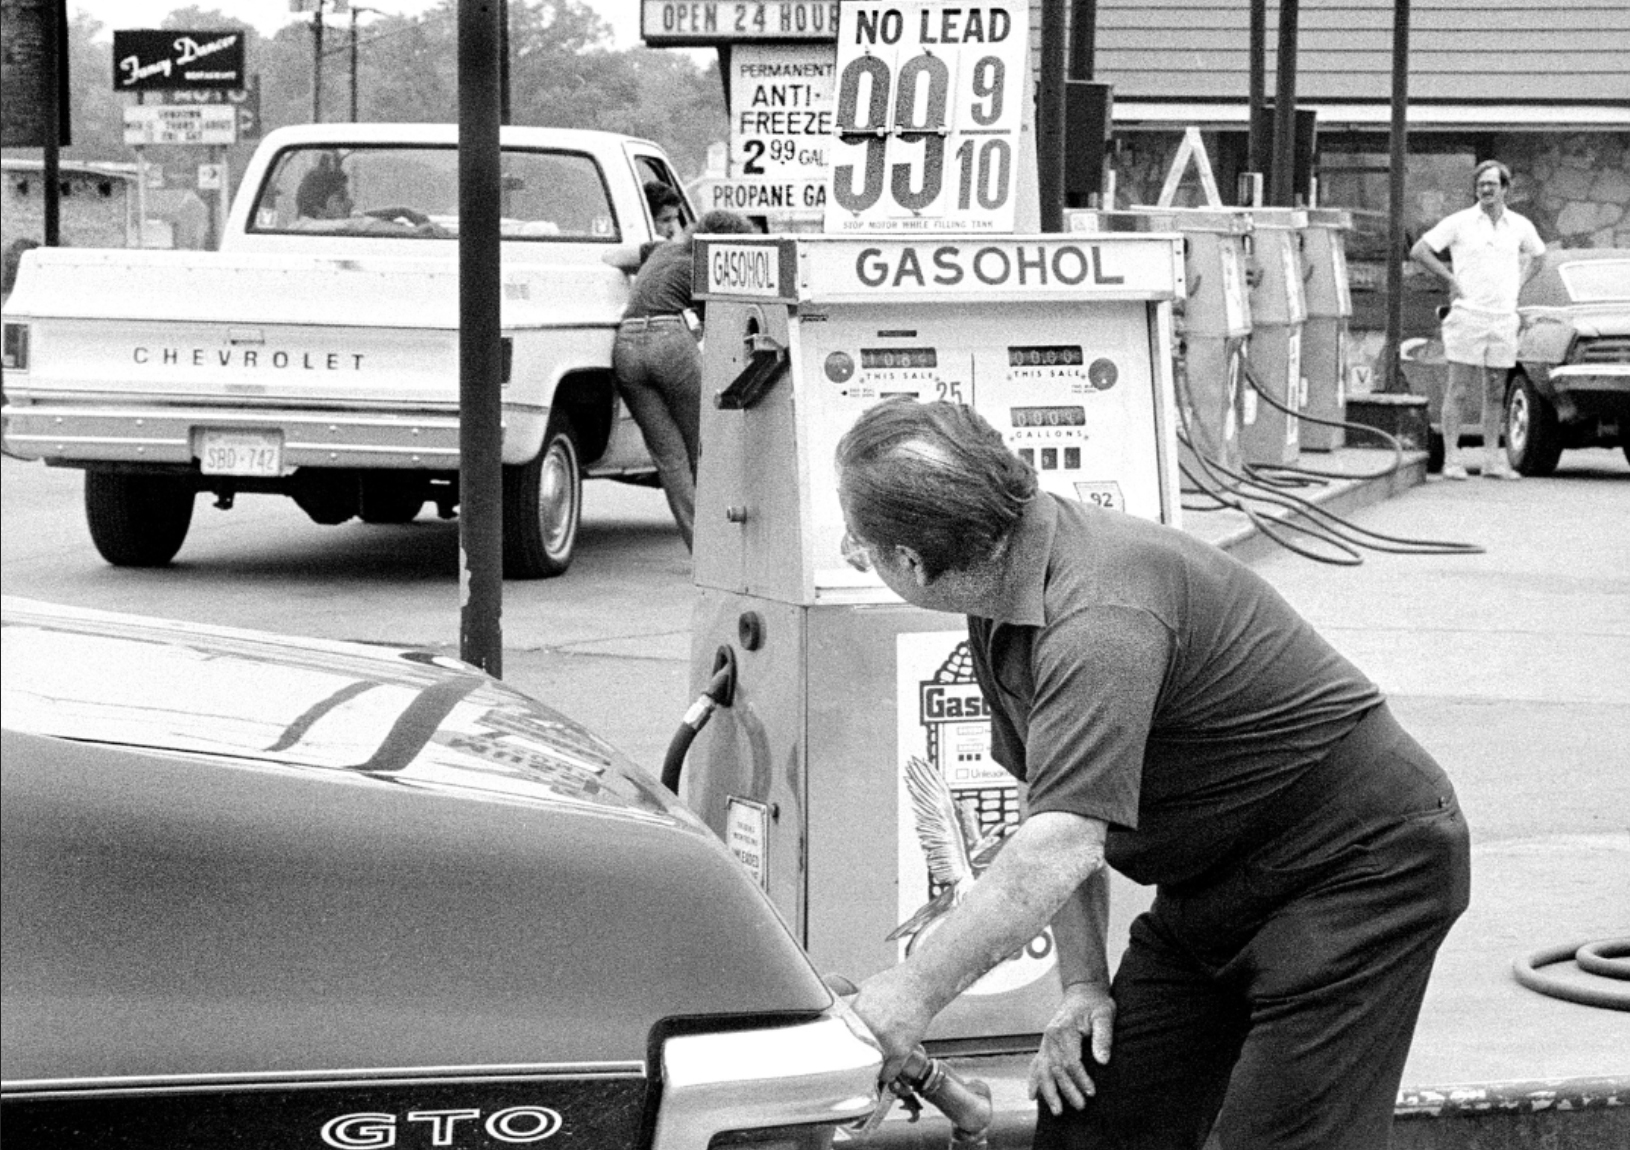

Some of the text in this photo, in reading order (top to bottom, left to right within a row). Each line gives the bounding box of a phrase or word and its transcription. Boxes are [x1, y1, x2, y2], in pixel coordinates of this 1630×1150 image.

[662, 3, 717, 33] OPEN
[734, 3, 766, 33] 24
[855, 8, 1012, 45] NO LEAD
[740, 62, 836, 77] PERMANENT
[740, 110, 833, 135] FREEZE
[832, 54, 949, 212] 99
[712, 184, 796, 208] PROPANE
[842, 220, 994, 229] STOP MOTOR WHILE FILLING TANK
[713, 250, 775, 289] GASOHOL
[855, 246, 1125, 287] GASOHOL
[132, 346, 365, 371] CHEVROLET
[867, 372, 934, 380] THIS SALE
[1014, 370, 1081, 378] THIS SALE
[1016, 430, 1083, 439] GALLONS
[1090, 492, 1114, 508] 92
[320, 1105, 563, 1150] GTO
